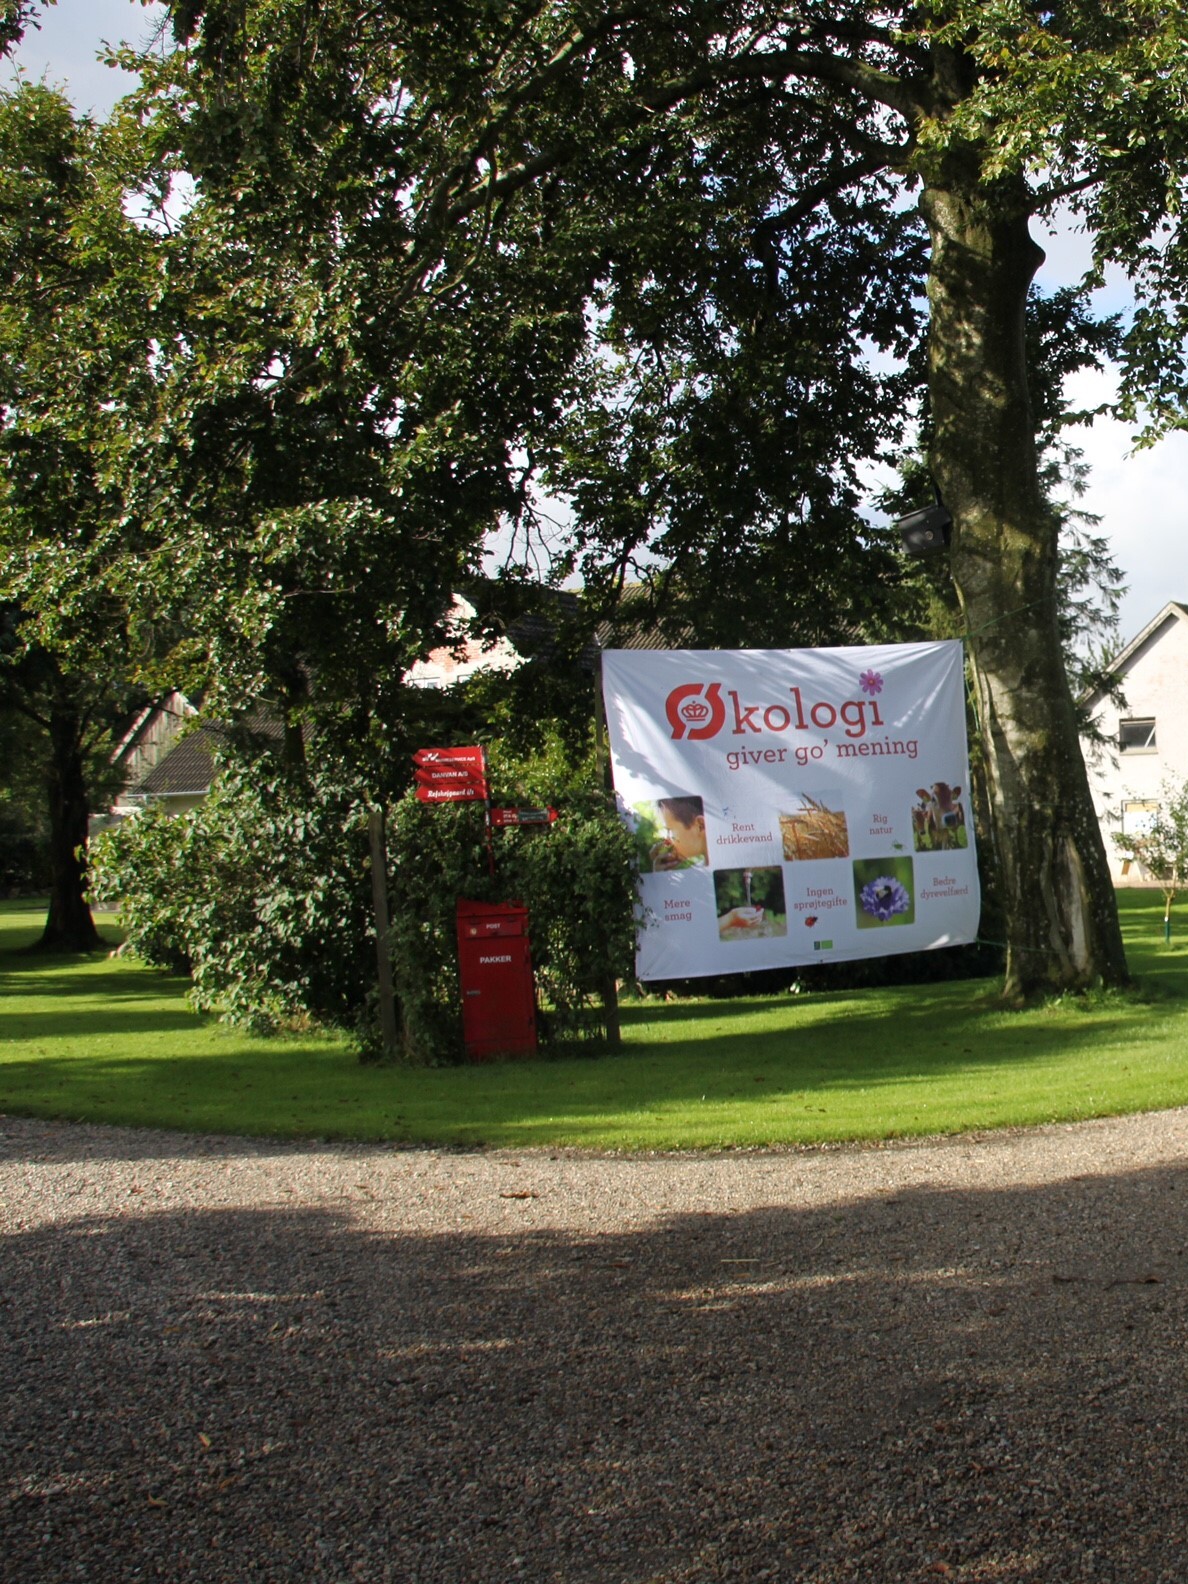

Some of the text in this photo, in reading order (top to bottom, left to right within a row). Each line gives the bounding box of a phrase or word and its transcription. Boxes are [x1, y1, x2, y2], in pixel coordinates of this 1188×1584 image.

[726, 746, 787, 770] giver
[836, 736, 919, 759] mening
[873, 814, 888, 826] Rig
[732, 822, 756, 833] Rent
[869, 825, 894, 836] natur
[716, 832, 773, 845] drikkevand
[932, 876, 957, 887] Bedre
[806, 887, 834, 899] Ingen
[920, 885, 969, 900] dyrevelfærd
[663, 899, 691, 909] Mere
[793, 896, 848, 912] sprøjtegifte
[664, 911, 692, 922] smag
[480, 955, 512, 964] PAKKER
